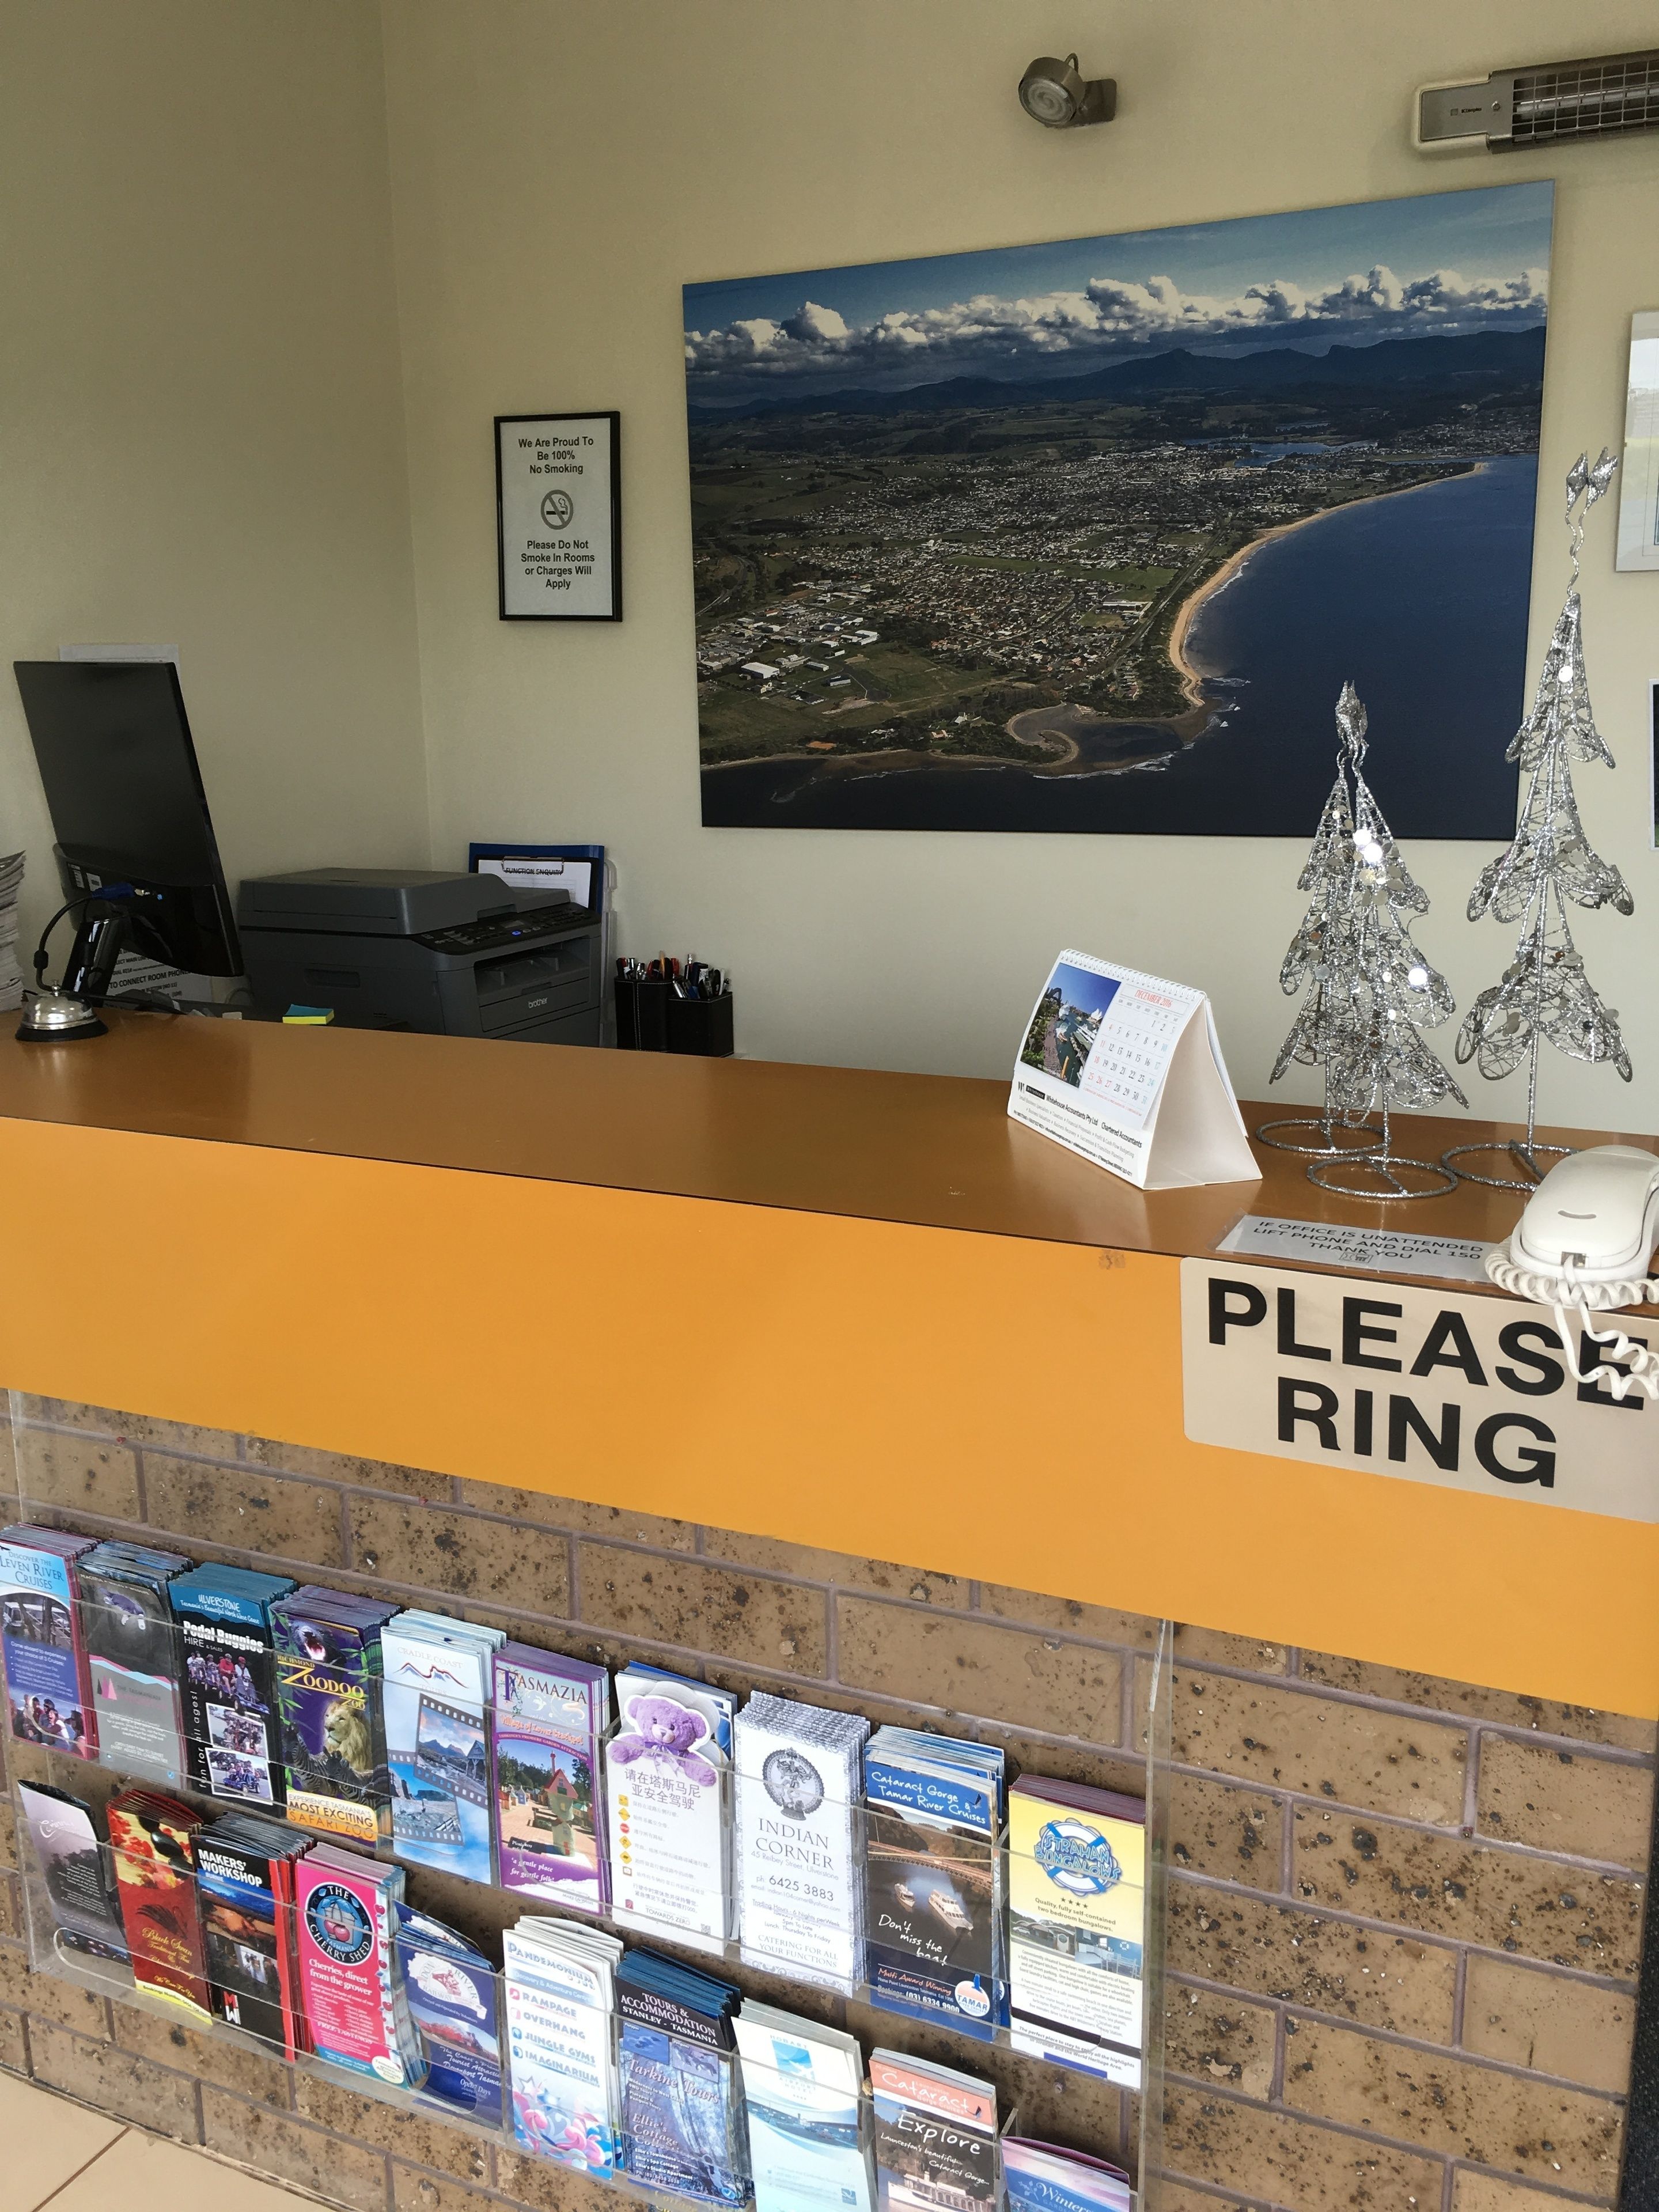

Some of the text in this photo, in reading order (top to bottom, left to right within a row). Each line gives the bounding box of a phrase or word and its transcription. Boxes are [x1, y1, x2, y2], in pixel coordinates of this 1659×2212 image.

[518, 436, 594, 448] We Are Proud To
[537, 450, 575, 460] Be 100%
[530, 464, 584, 475] No Smoking
[521, 553, 595, 562] Smoke In Rooms
[527, 540, 589, 550] Please Do Not
[525, 566, 592, 577] or Charges Will
[546, 579, 571, 590] Apply
[119, 976, 146, 987] CONNECT
[147, 973, 167, 981] ROOM
[528, 997, 548, 1008] brother
[1135, 990, 1173, 1008] DECEMBER 2016
[1103, 1059, 1108, 1067] 19
[1110, 1062, 1117, 1071] 20
[1119, 1066, 1126, 1075] 21
[1128, 1070, 1136, 1079] 22
[1047, 1096, 1142, 1148] Whitehouse Accountants Chartered Accountants
[1253, 1228, 1284, 1236] LIFT
[1291, 1233, 1351, 1245] PHONE
[1357, 1241, 1395, 1249] AND
[1402, 1246, 1441, 1255] DIAL
[1278, 1224, 1336, 1236] OFFICE
[1362, 1234, 1483, 1252] UNATTENDED
[1309, 1243, 1412, 1259] THANK YOU
[1207, 1277, 1647, 1411] PLEASE
[1278, 1376, 1556, 1488] RING
[0, 1556, 64, 1582] LEVEN RIVER
[8, 1551, 52, 1567] DISCOVER THE
[15, 1571, 52, 1589] CRUISES
[198, 1594, 241, 1612] ULVERSTONE
[183, 1620, 263, 1654] Pedal Buggies
[184, 1636, 204, 1648] HIRE
[277, 1655, 315, 1668] RICHMOND
[397, 1647, 463, 1668] CRADLE COAST
[278, 1661, 365, 1702] ZOODOO
[497, 1667, 588, 1704] TASMAZIA
[190, 1691, 200, 1724] ages!
[340, 1697, 365, 1711] ZOO
[624, 1768, 701, 1798] 请在塔斯马尼
[872, 1771, 971, 1812] Cataract Gorge &
[289, 1794, 372, 1818] EXPERIENCE TASMANIA'S
[632, 1783, 695, 1810] 亚安全驾驶
[878, 1785, 986, 1824] Tamar River Cruises
[290, 1801, 373, 1827] MOST EXCITING
[290, 1811, 373, 1839] SAFARI ZOO
[758, 1817, 828, 1850] INDIAN
[198, 1849, 246, 1871] MAKERS'
[756, 1838, 834, 1870] CORNER
[1044, 1835, 1109, 1863] STRAHAN
[200, 1859, 263, 1887] WORKSHOP
[763, 1853, 783, 1866] Reibey
[786, 1859, 804, 1871] Street,
[806, 1865, 839, 1880] Ulverstone
[1035, 1844, 1122, 1882] BUNGALOWS
[327, 1886, 349, 1900] THE
[770, 1876, 834, 1902] 6425 3883
[646, 1908, 674, 1921] TOWARDS
[675, 1915, 691, 1926] ZERO
[1035, 1897, 1116, 1925] Quality, fully self-contained
[1050, 1909, 1077, 1921] bedroom
[1079, 1917, 1113, 1931] bungalows.
[783, 1926, 806, 1936] Thursday
[815, 1934, 831, 1944] Friday
[878, 1914, 911, 1934] Don't
[310, 1925, 370, 1961] CHERRY SHED
[326, 1937, 354, 1952] TASMANIA
[758, 1935, 838, 1960] CATERING FOR ALL
[900, 1933, 942, 1952] miss the
[507, 1941, 594, 1984] PANDEMONIUM
[759, 1943, 837, 1968] YOUR FUNCTIONS
[309, 1958, 368, 1984] Cherries, direct
[309, 1968, 373, 1996] from the grower
[878, 1968, 952, 1995] Multi Award Winning
[522, 1992, 577, 2017] RAMPAGE
[642, 1993, 689, 2018] TOURS &
[958, 1995, 987, 2010] TAMAR
[524, 2012, 586, 2040] OVERHANG
[621, 1994, 715, 2037] ACCOMMODATION
[623, 2006, 718, 2046] STANLEY TASMANIA
[525, 2032, 596, 2064] JUNGLE GYMS
[770, 2035, 806, 2048] HOBART
[446, 2054, 470, 2067] Tourist
[525, 2051, 599, 2084] IMAGINARIUM
[628, 2059, 720, 2104] Tarkine Tours
[779, 2077, 816, 2090] AIRPORT
[785, 2084, 812, 2094] HOTEL
[882, 2072, 969, 2110] Cataract
[632, 2113, 667, 2132] Ellie's
[634, 2124, 678, 2146] Cottage
[897, 2109, 980, 2154] Explore
[881, 2133, 922, 2152] Launceston's
[929, 2160, 963, 2176] Cataract
